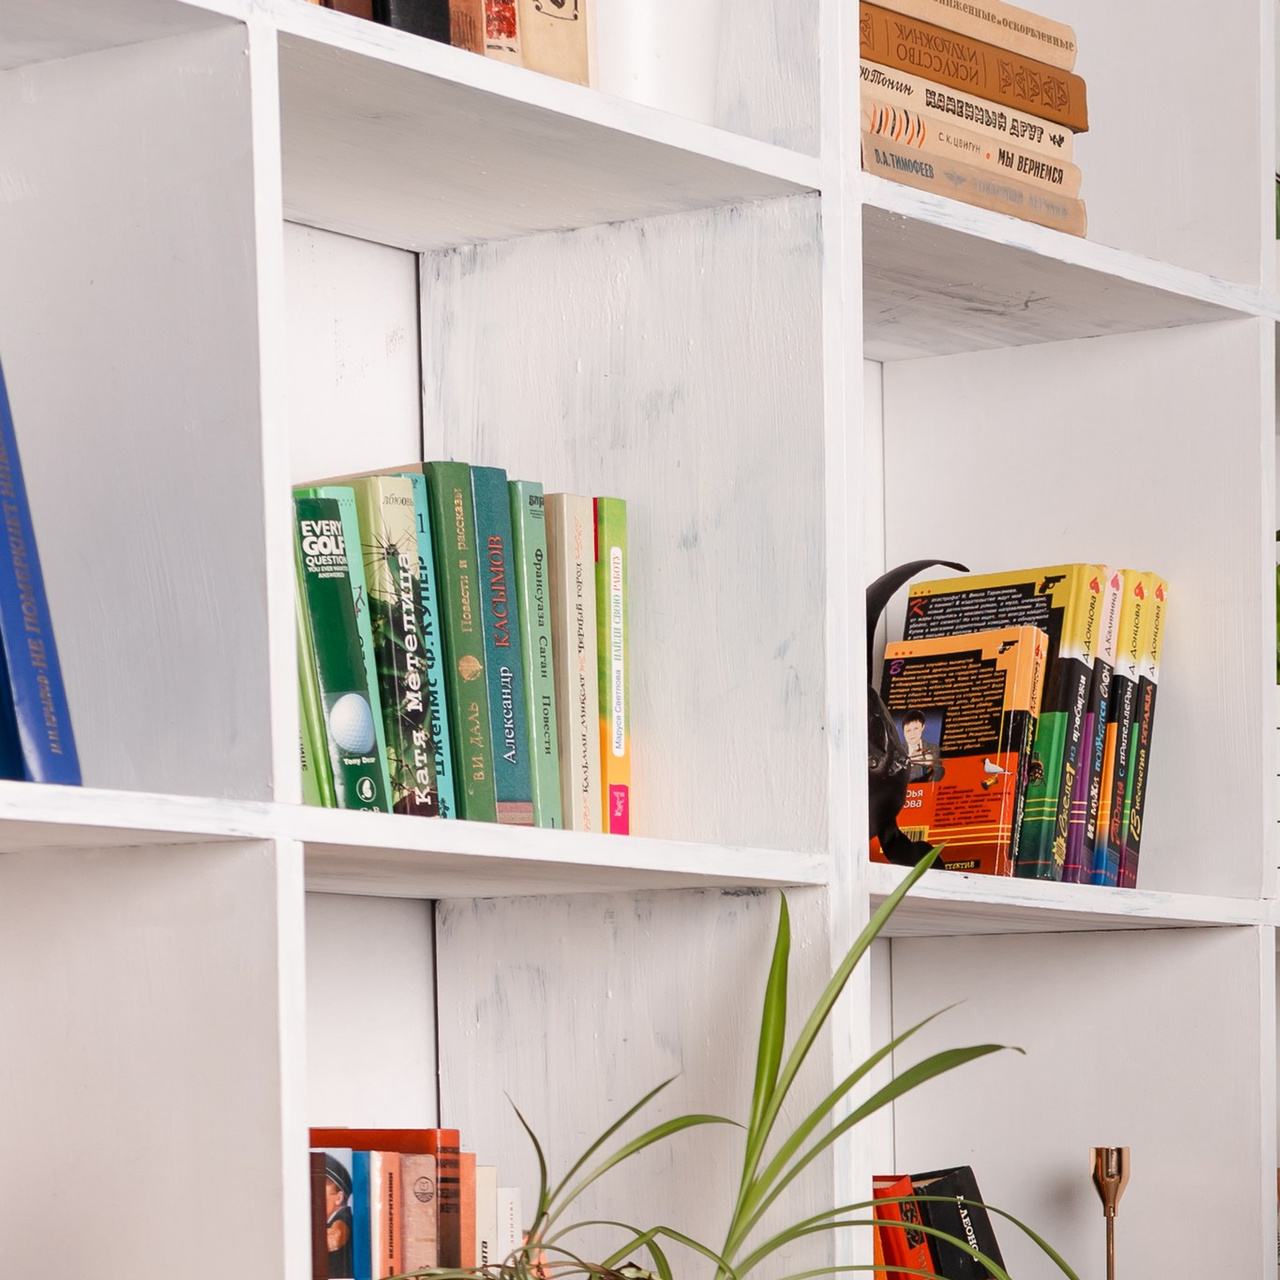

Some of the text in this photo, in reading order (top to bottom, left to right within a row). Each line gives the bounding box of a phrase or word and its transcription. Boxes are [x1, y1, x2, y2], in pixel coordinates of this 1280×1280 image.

[896, 44, 979, 85] ИСКУССТВО
[997, 148, 1063, 184] МЫ ВЕРНЕМСЯ
[301, 520, 341, 536] EVERY
[485, 534, 521, 764] Александр КАСЫМОВ
[530, 547, 555, 755] Франсуаза Саган Повести
[609, 551, 624, 749] Маруся Светлова НАЙДИ СВОЮ РАБОТУ
[1124, 601, 1143, 658] Донцова
[1145, 603, 1164, 660] Донцова
[393, 550, 433, 806] Катя Метелица
[467, 700, 483, 749] ДАЛЬ
